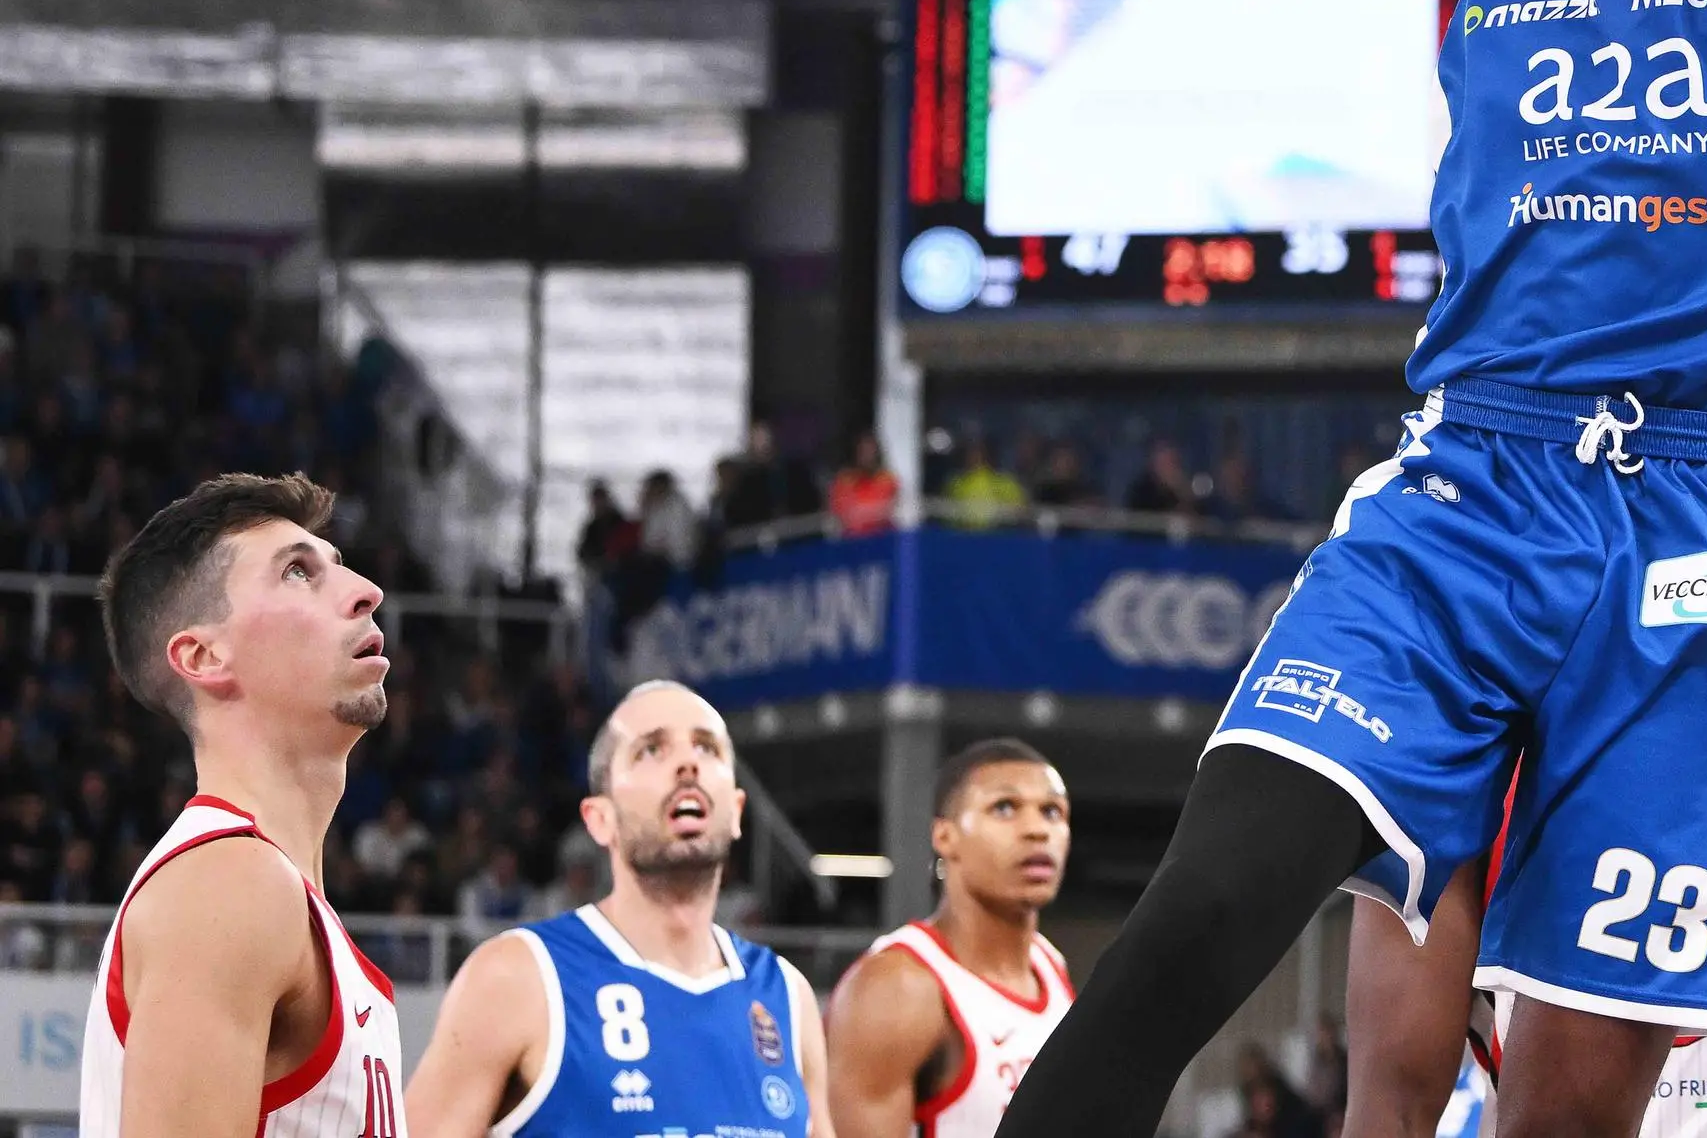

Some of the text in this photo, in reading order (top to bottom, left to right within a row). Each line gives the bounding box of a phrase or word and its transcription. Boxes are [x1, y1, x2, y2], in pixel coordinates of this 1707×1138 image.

[1523, 136, 1569, 161] LIFE
[1281, 667, 1329, 683] GRUPPO
[596, 983, 650, 1062] 8
